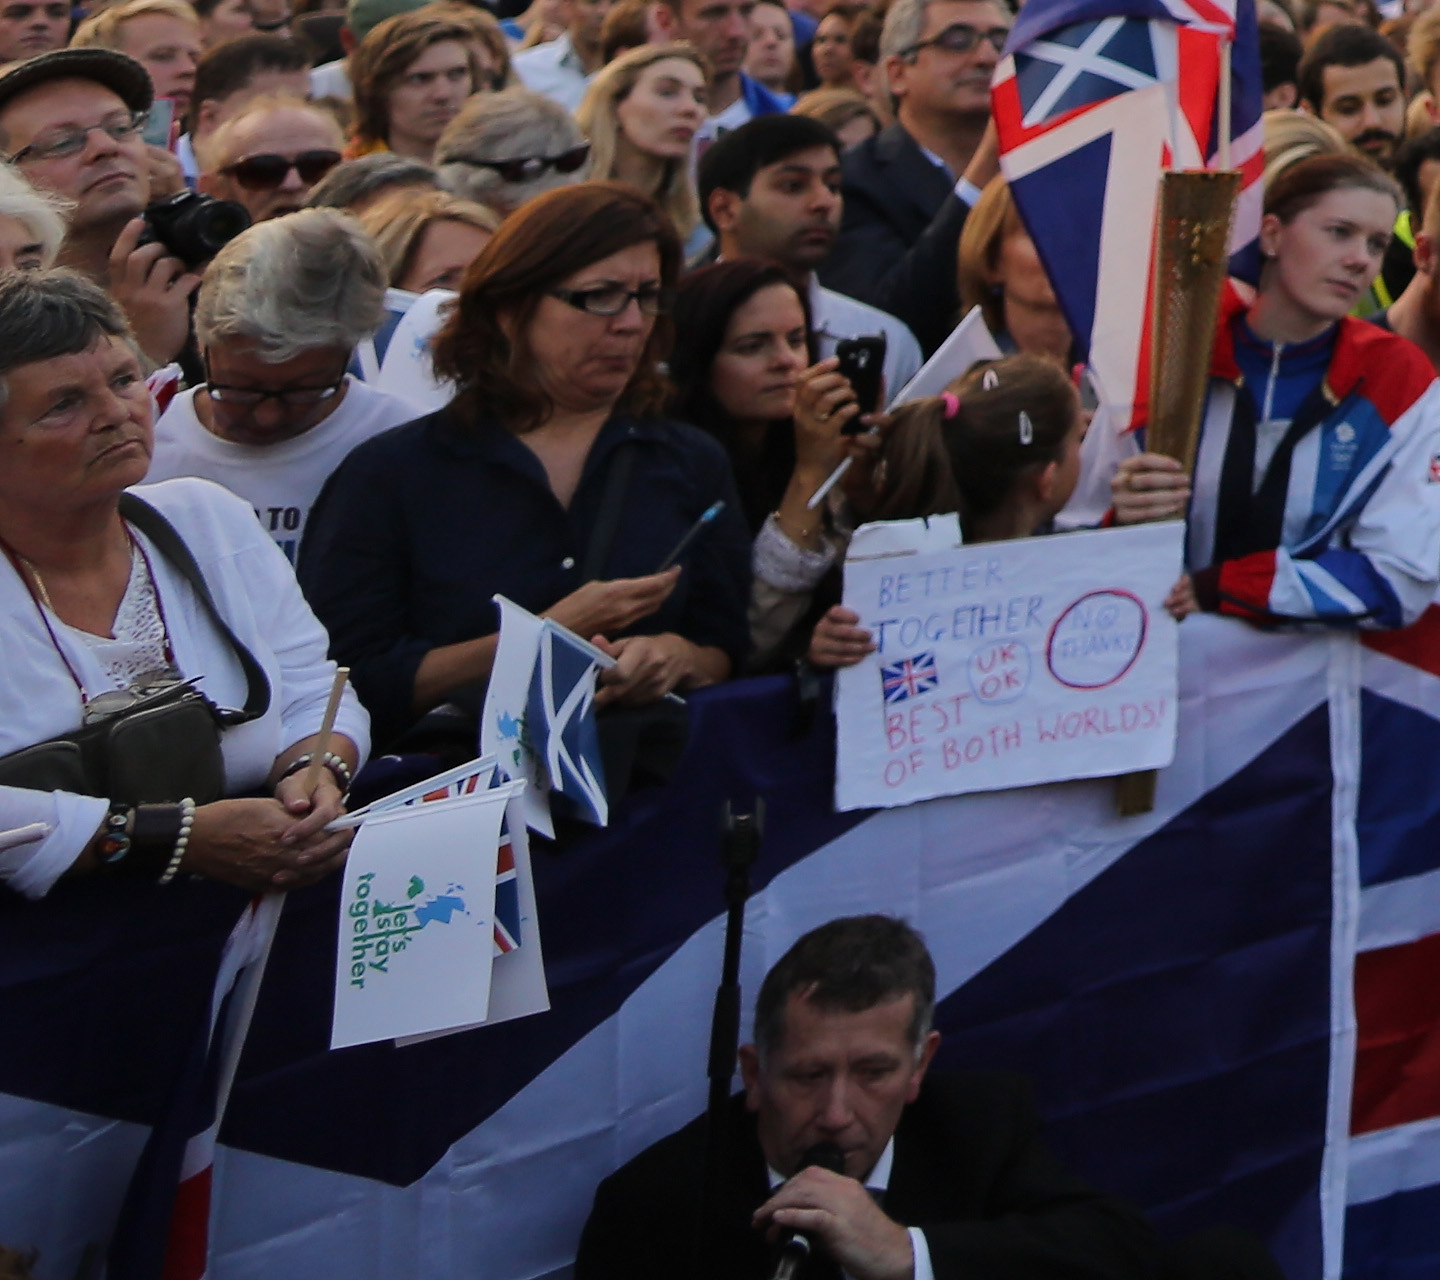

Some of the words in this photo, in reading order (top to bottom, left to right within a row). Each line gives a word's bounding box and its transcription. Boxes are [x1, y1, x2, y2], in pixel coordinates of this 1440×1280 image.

[267, 506, 301, 531] TO
[878, 556, 1004, 608] BETTER
[873, 596, 1044, 654] TOGETHER
[1073, 605, 1120, 631] NO
[976, 642, 1017, 674] UK
[979, 671, 1021, 700] OK
[883, 753, 925, 788] OF
[943, 720, 1021, 770] BOTH
[1037, 699, 1166, 743] WORLDS!
[885, 693, 972, 751] BEST
[348, 871, 376, 990] together
[369, 918, 392, 974] stay
[391, 902, 423, 954] let's
